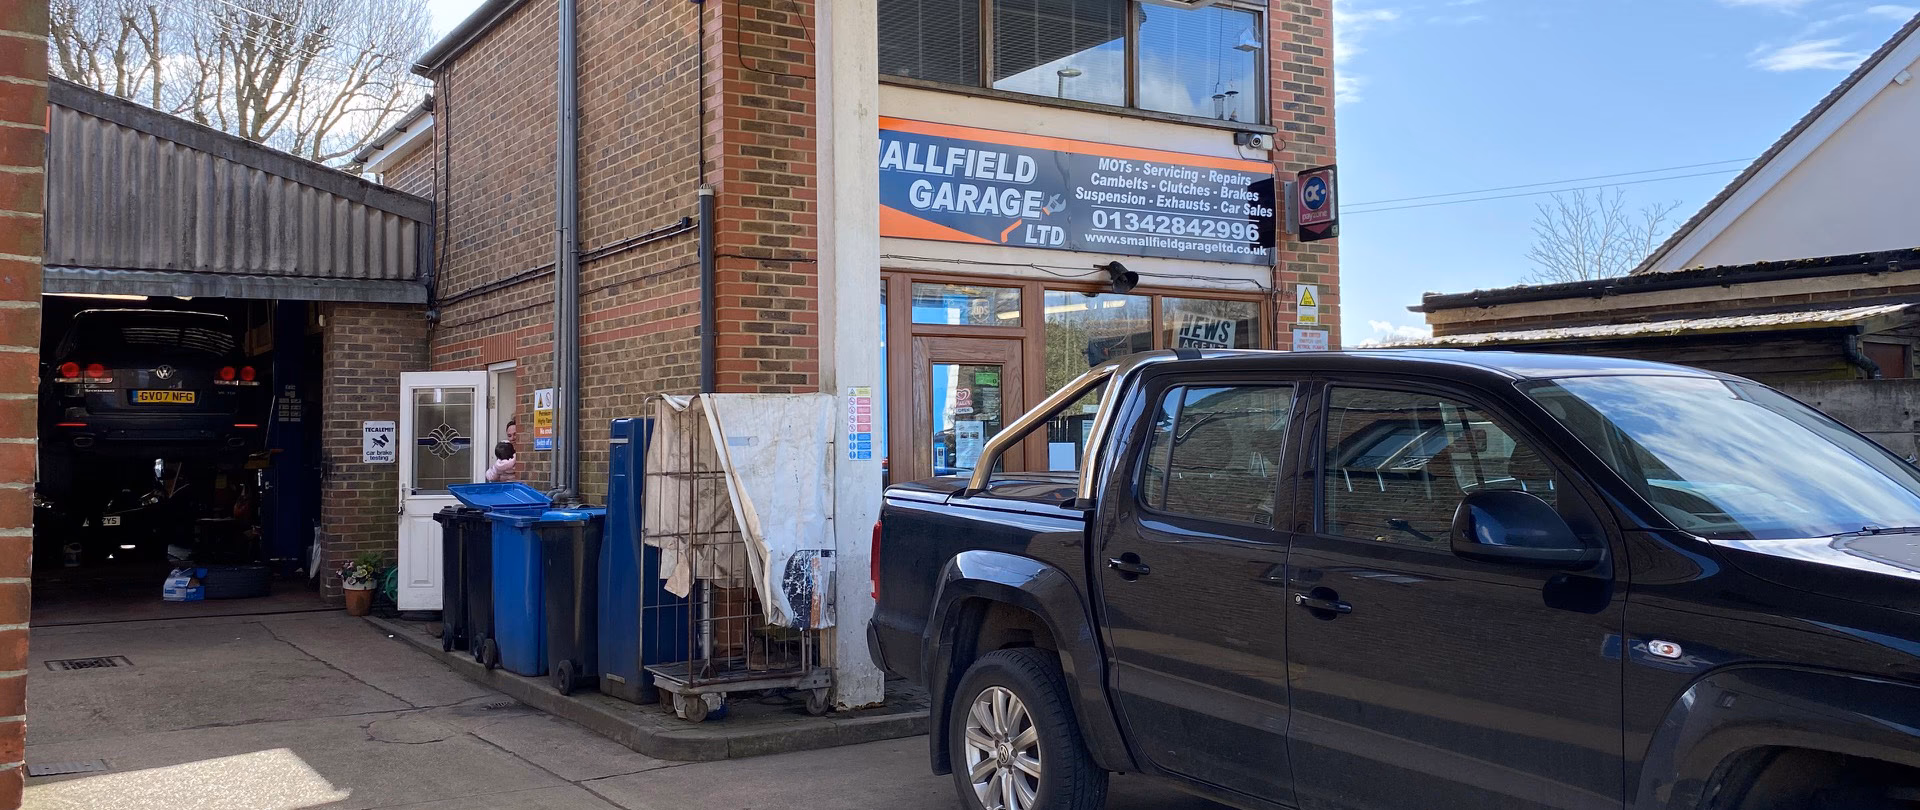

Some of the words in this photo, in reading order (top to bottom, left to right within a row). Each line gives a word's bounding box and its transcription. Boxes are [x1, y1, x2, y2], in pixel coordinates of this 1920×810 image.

[879, 139, 1037, 184] ALLFIELD
[1098, 158, 1133, 173] MOTs
[1143, 163, 1199, 183] Servicing
[1209, 170, 1252, 186] Repairs
[909, 179, 1043, 219] GARAGE
[1075, 187, 1146, 204] Suspension
[1156, 195, 1210, 211] Exhausts
[1221, 201, 1240, 214] Car
[1243, 203, 1273, 217] Sales
[1091, 173, 1149, 190] Cambelts
[1159, 180, 1210, 196] Clutches
[1220, 186, 1259, 202] Brakes
[1025, 224, 1065, 246] LTD
[1092, 210, 1260, 241] 01342842996
[1085, 234, 1267, 256] www.smallfieldgarageltd.co.uk
[1180, 313, 1231, 343] NEWS
[141, 391, 169, 401] GV07
[172, 391, 193, 402] NFG
